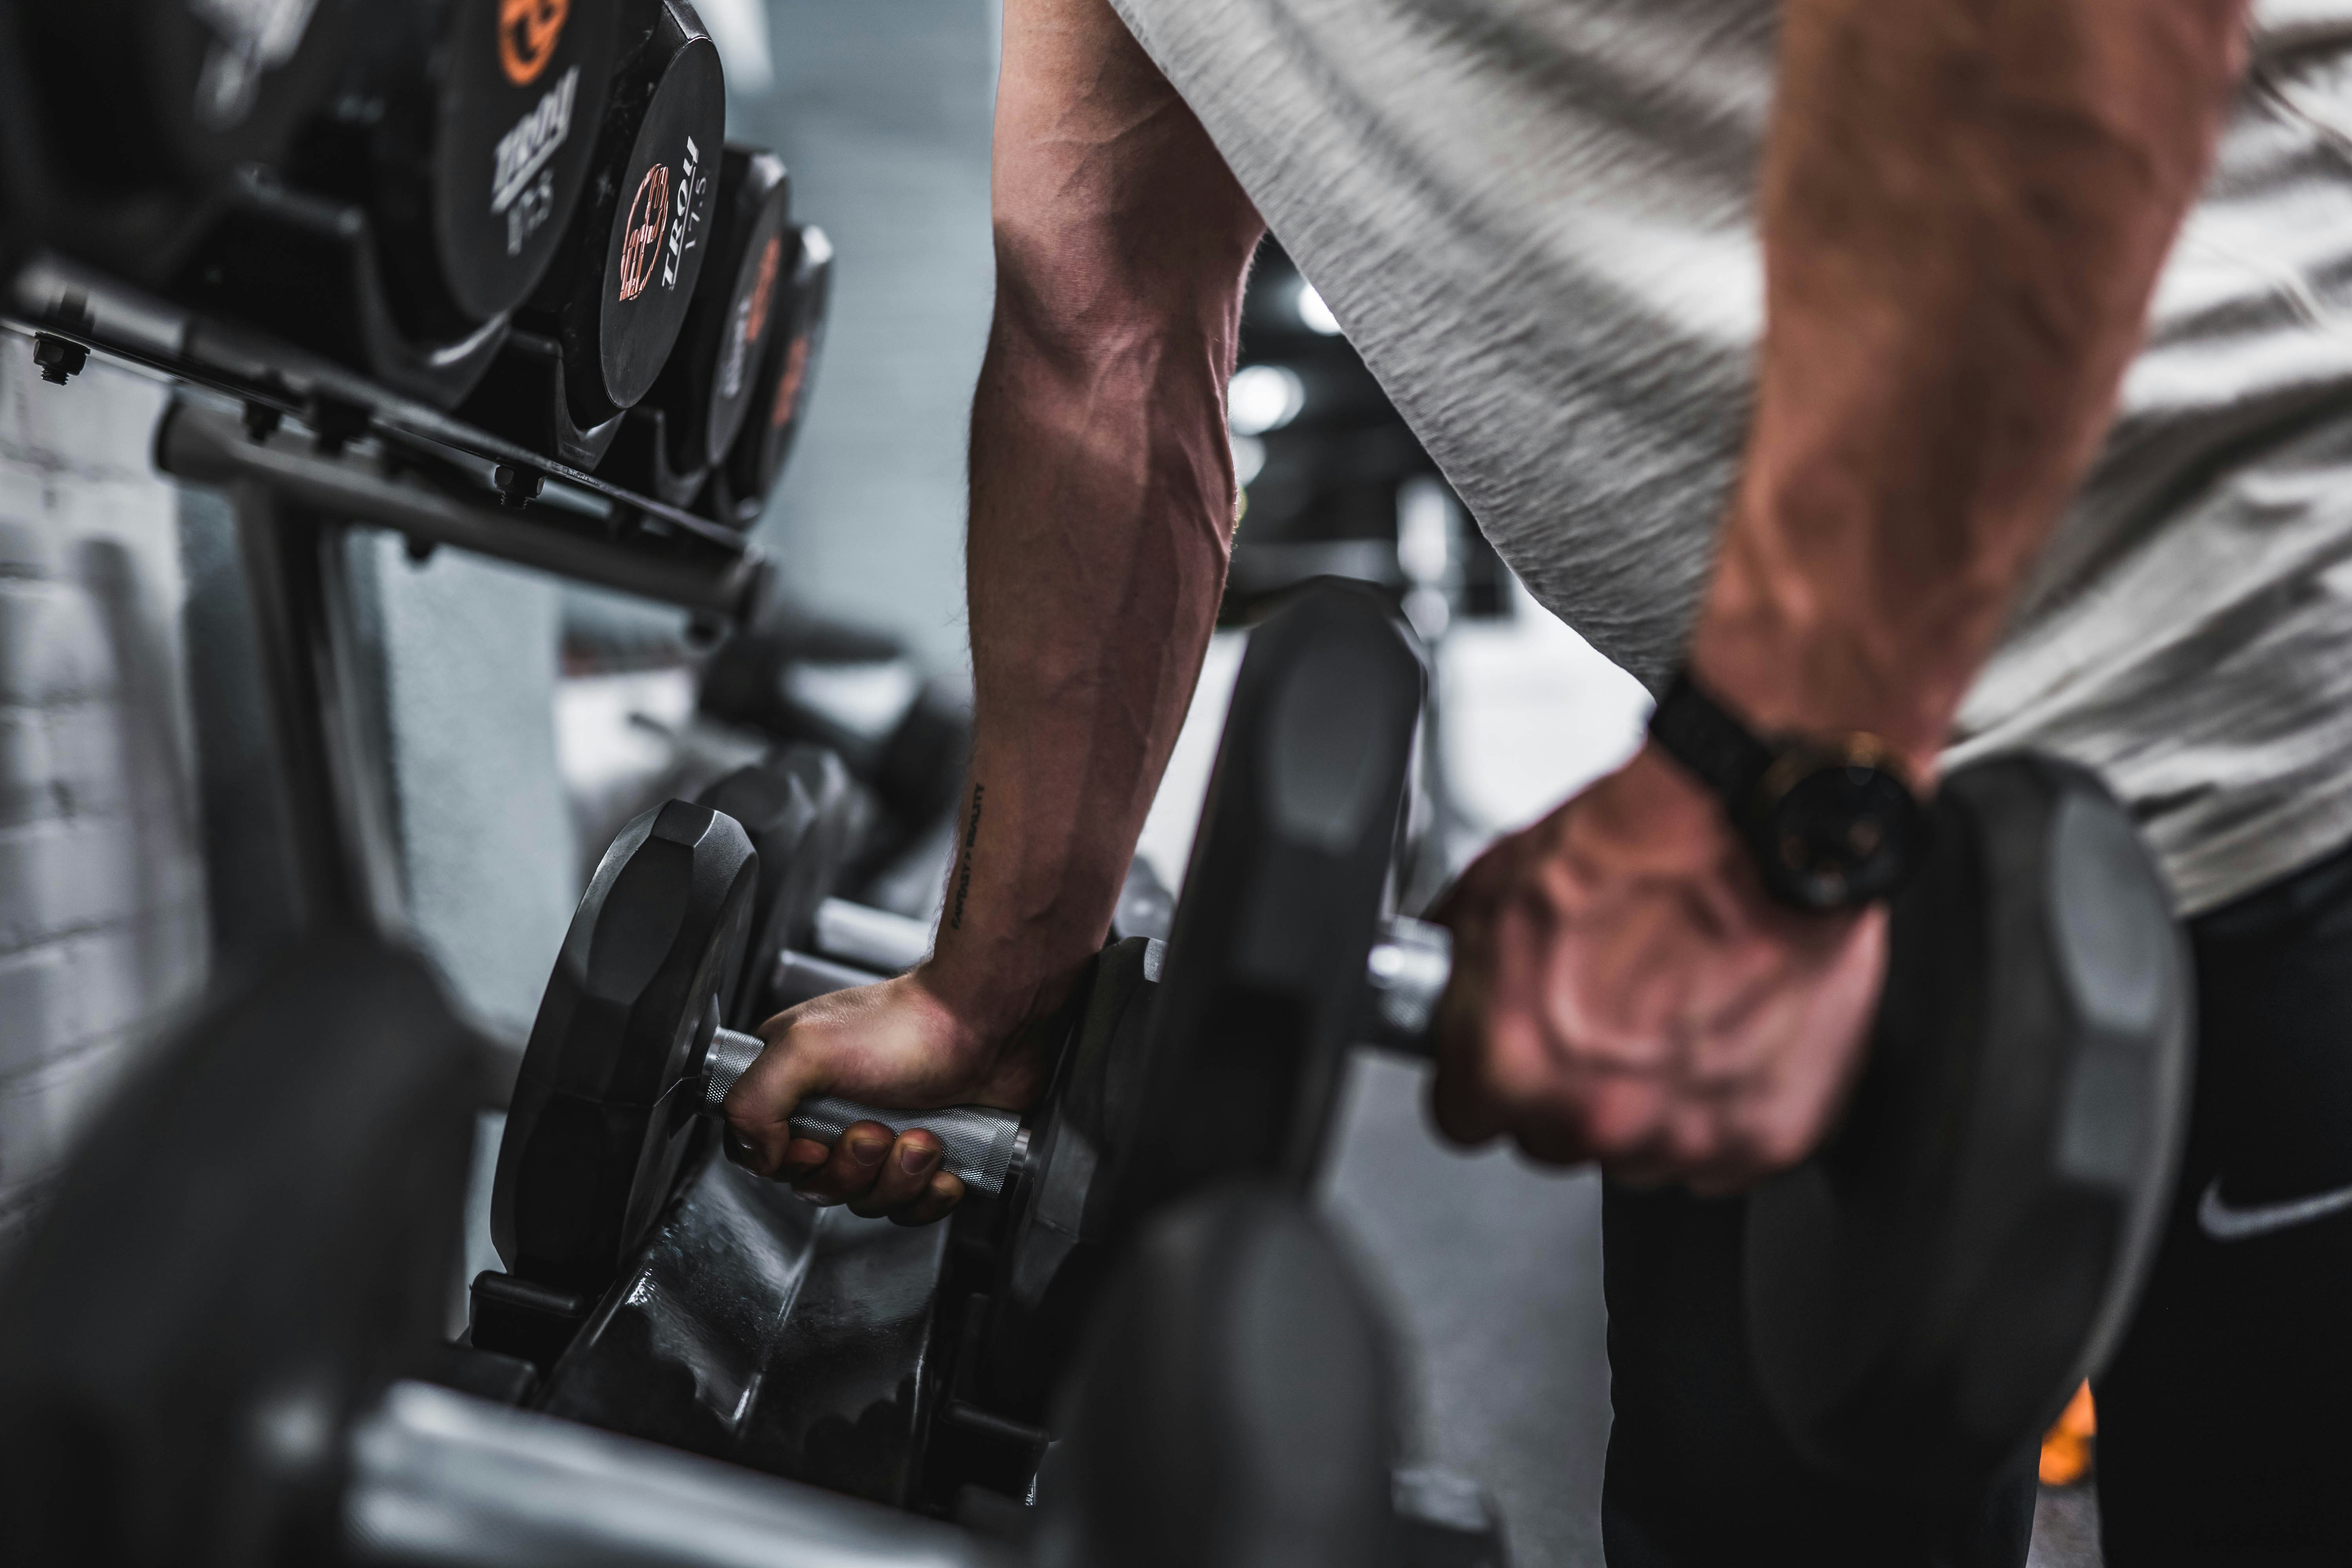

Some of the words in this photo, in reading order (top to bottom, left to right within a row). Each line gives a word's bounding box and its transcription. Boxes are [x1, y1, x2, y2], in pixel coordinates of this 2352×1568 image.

[662, 135, 699, 287] TROY
[685, 177, 706, 251] 17.5
[951, 862, 971, 929] FANTASY
